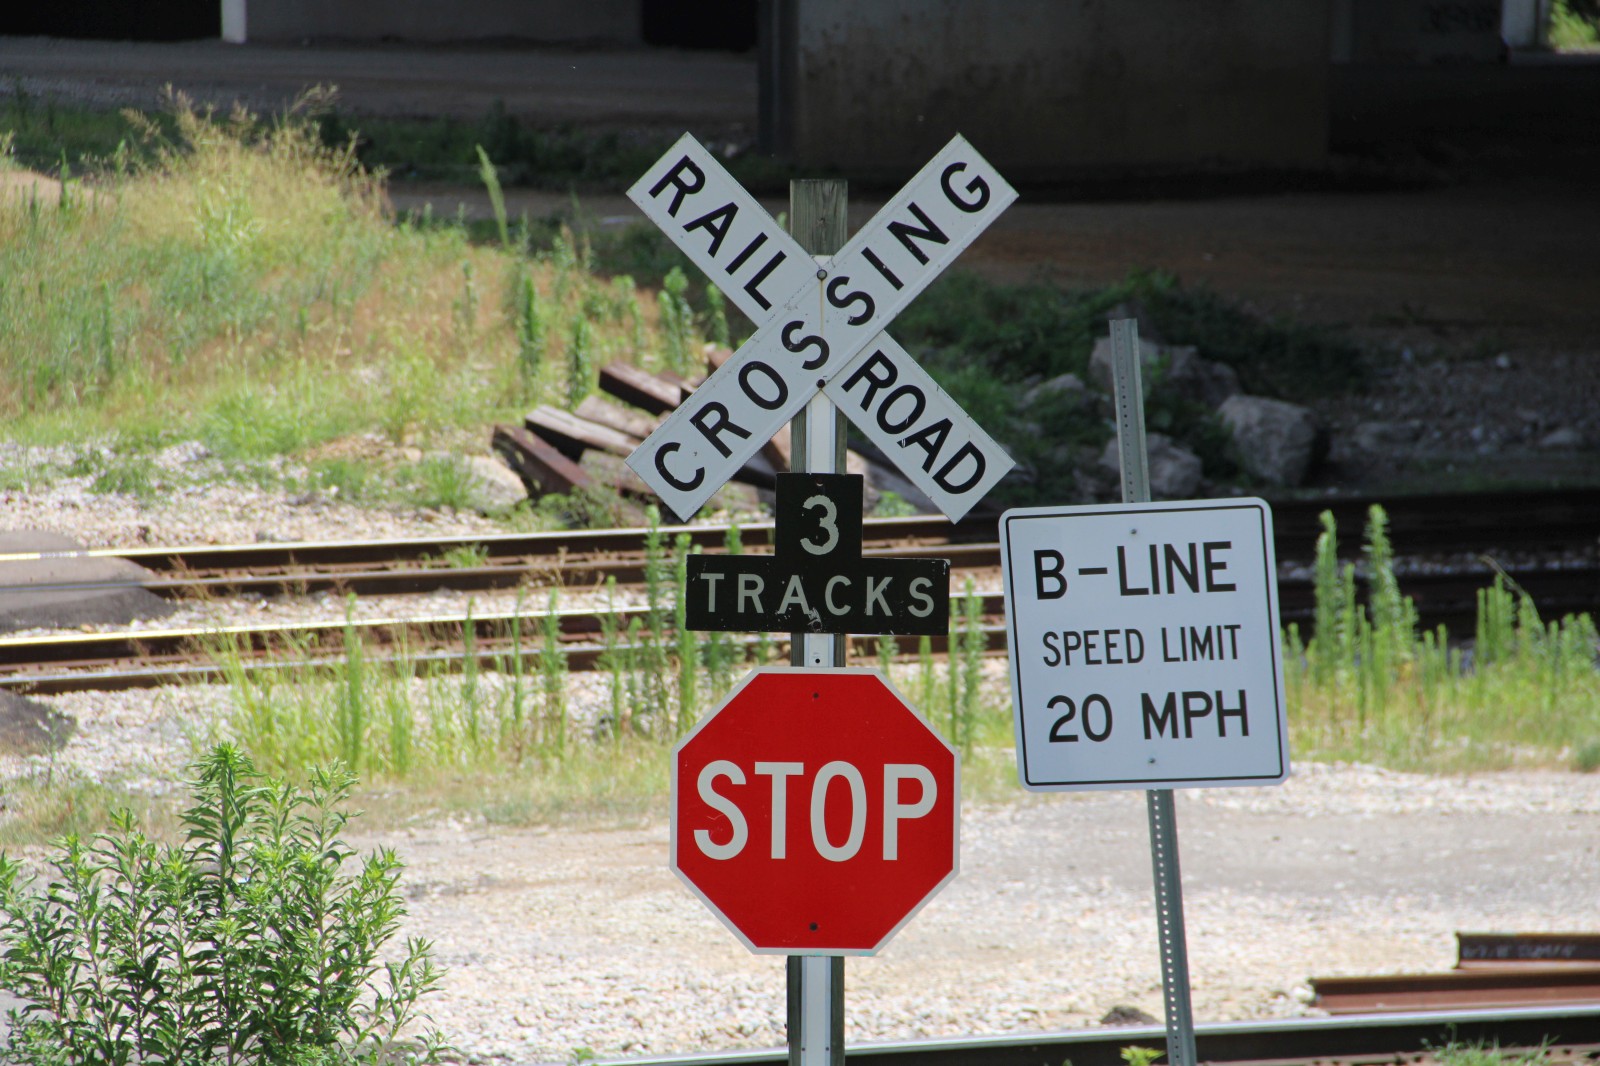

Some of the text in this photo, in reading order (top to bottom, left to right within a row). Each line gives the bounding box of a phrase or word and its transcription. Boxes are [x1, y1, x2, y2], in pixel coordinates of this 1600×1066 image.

[648, 155, 787, 311] RAIL
[654, 162, 991, 492] CROSSING
[841, 350, 986, 495] ROAD
[800, 495, 840, 556] 3
[700, 573, 935, 618] TRACKS
[1033, 541, 1237, 600] B-LINE
[1042, 624, 1242, 667] SPEED LIMIT
[1046, 689, 1250, 743] 20 MPH
[693, 759, 938, 862] STOP
